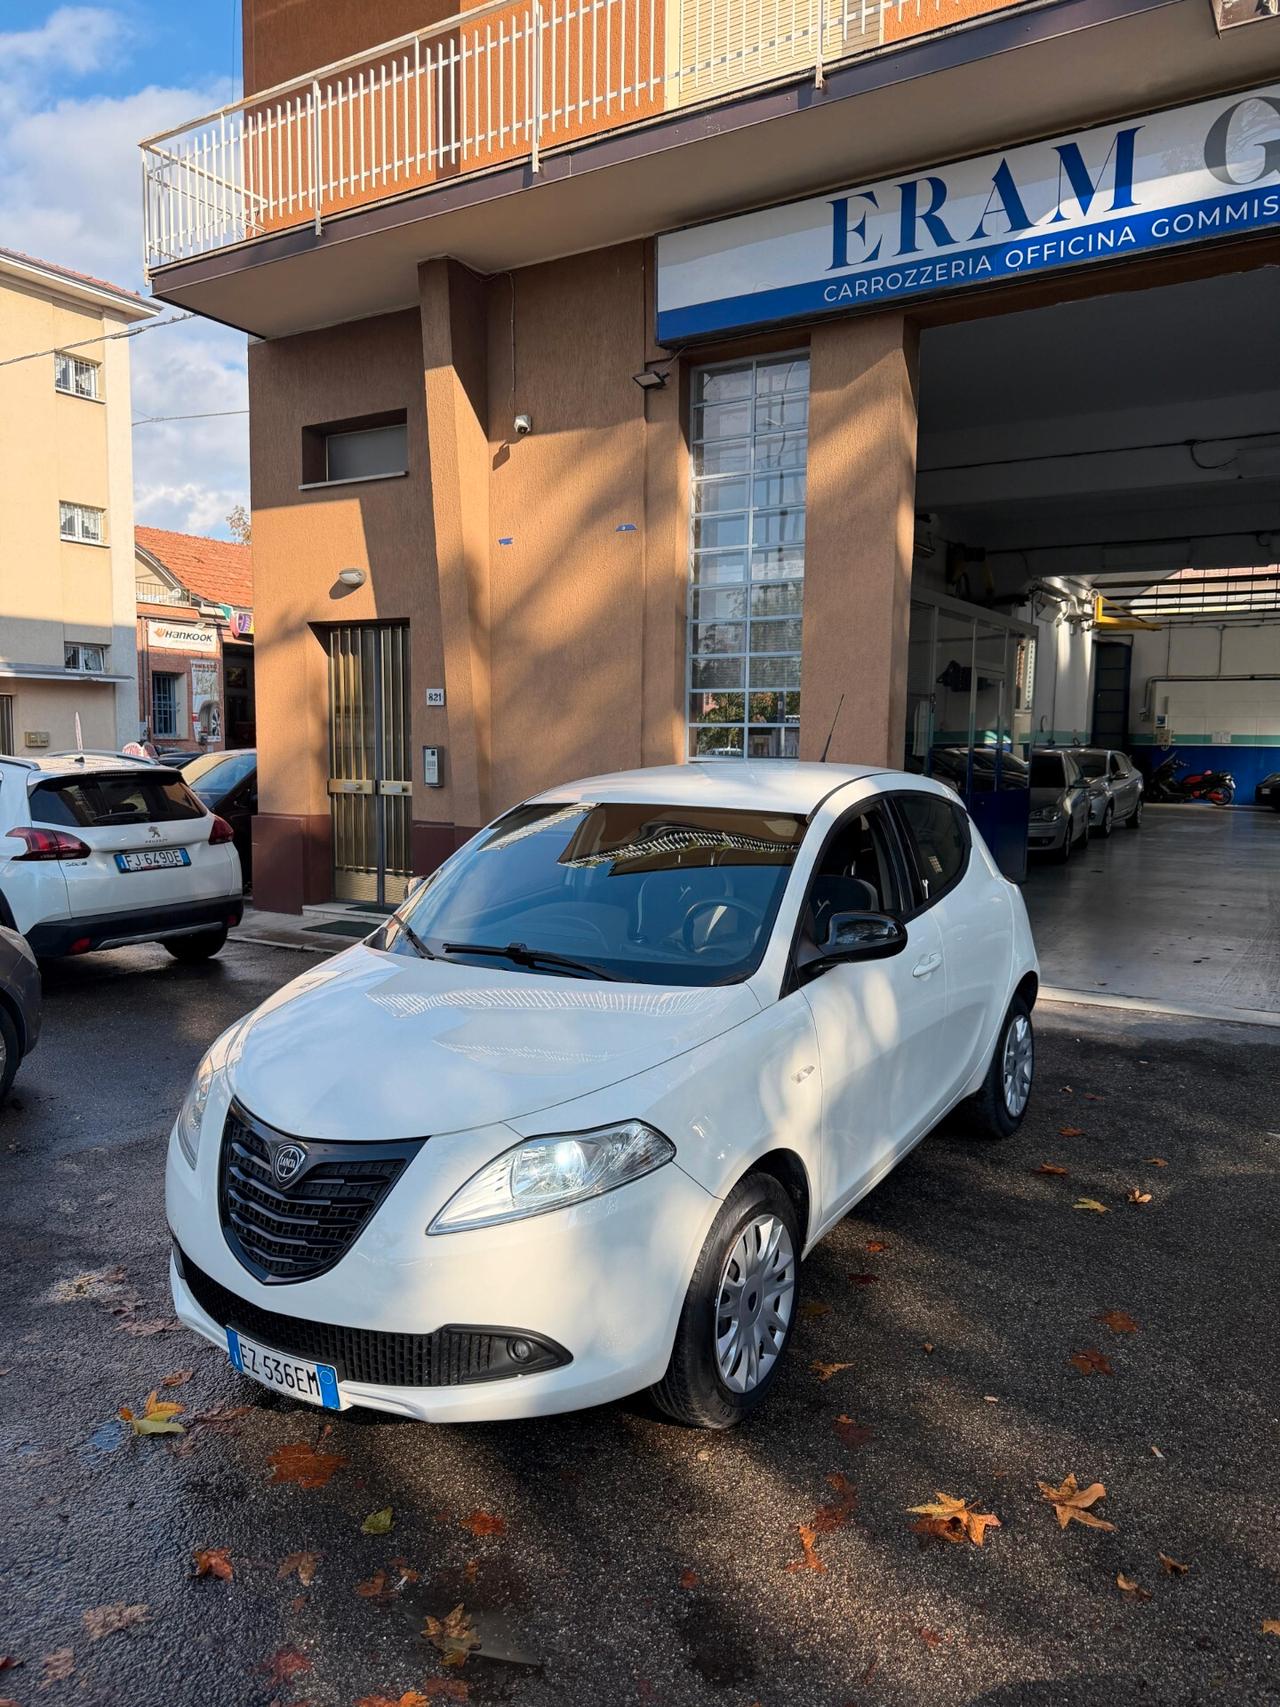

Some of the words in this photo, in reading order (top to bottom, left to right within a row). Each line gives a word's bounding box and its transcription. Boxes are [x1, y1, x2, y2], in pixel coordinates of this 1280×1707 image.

[824, 255, 992, 302] CARROZZERIA
[1005, 226, 1136, 267] OFFICINA
[1151, 195, 1280, 237] GOMMIS
[825, 125, 1146, 271] ERAM
[428, 693, 442, 702] 821
